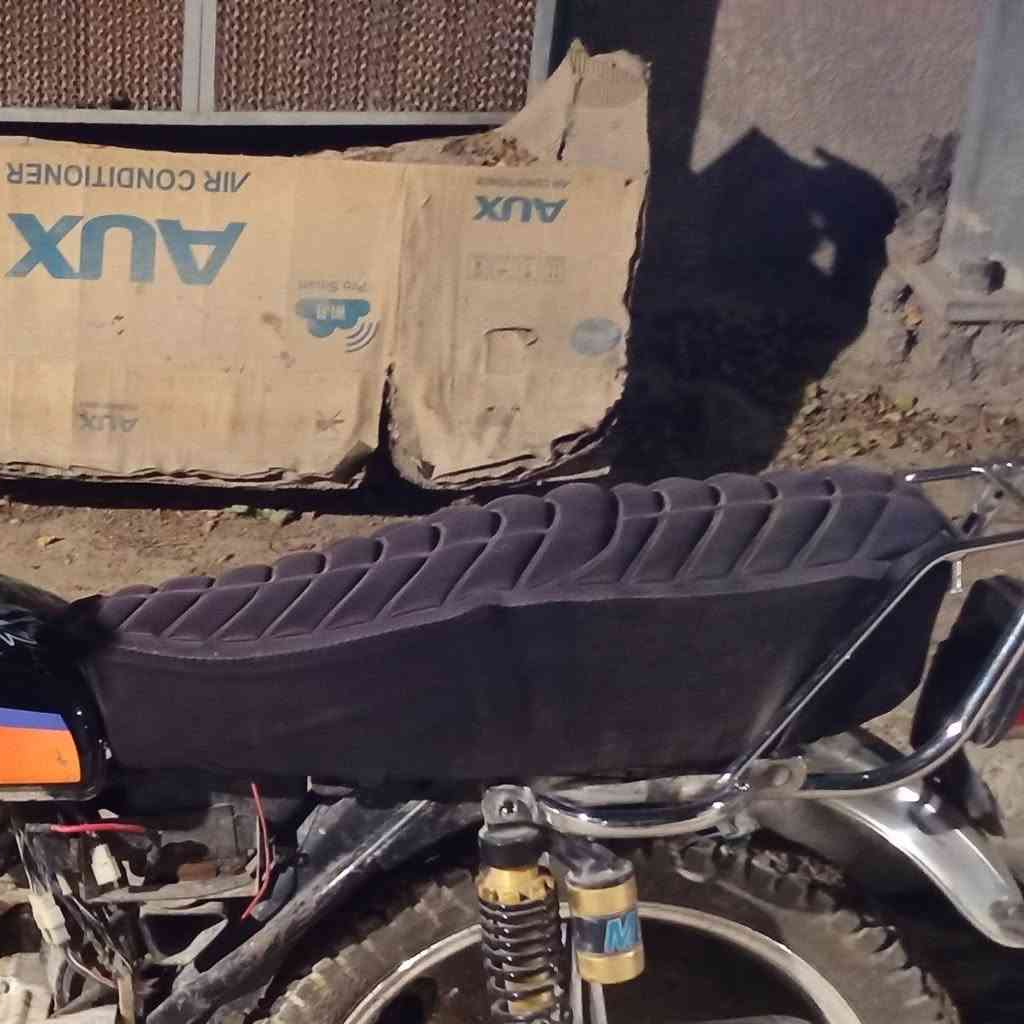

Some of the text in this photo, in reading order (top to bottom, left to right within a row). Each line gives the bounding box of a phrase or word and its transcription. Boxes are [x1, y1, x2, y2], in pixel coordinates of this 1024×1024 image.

[7, 162, 251, 192] AIR CONDITIONER
[472, 196, 568, 223] AUX
[5, 213, 248, 286] AUX
[79, 413, 139, 432] AUX
